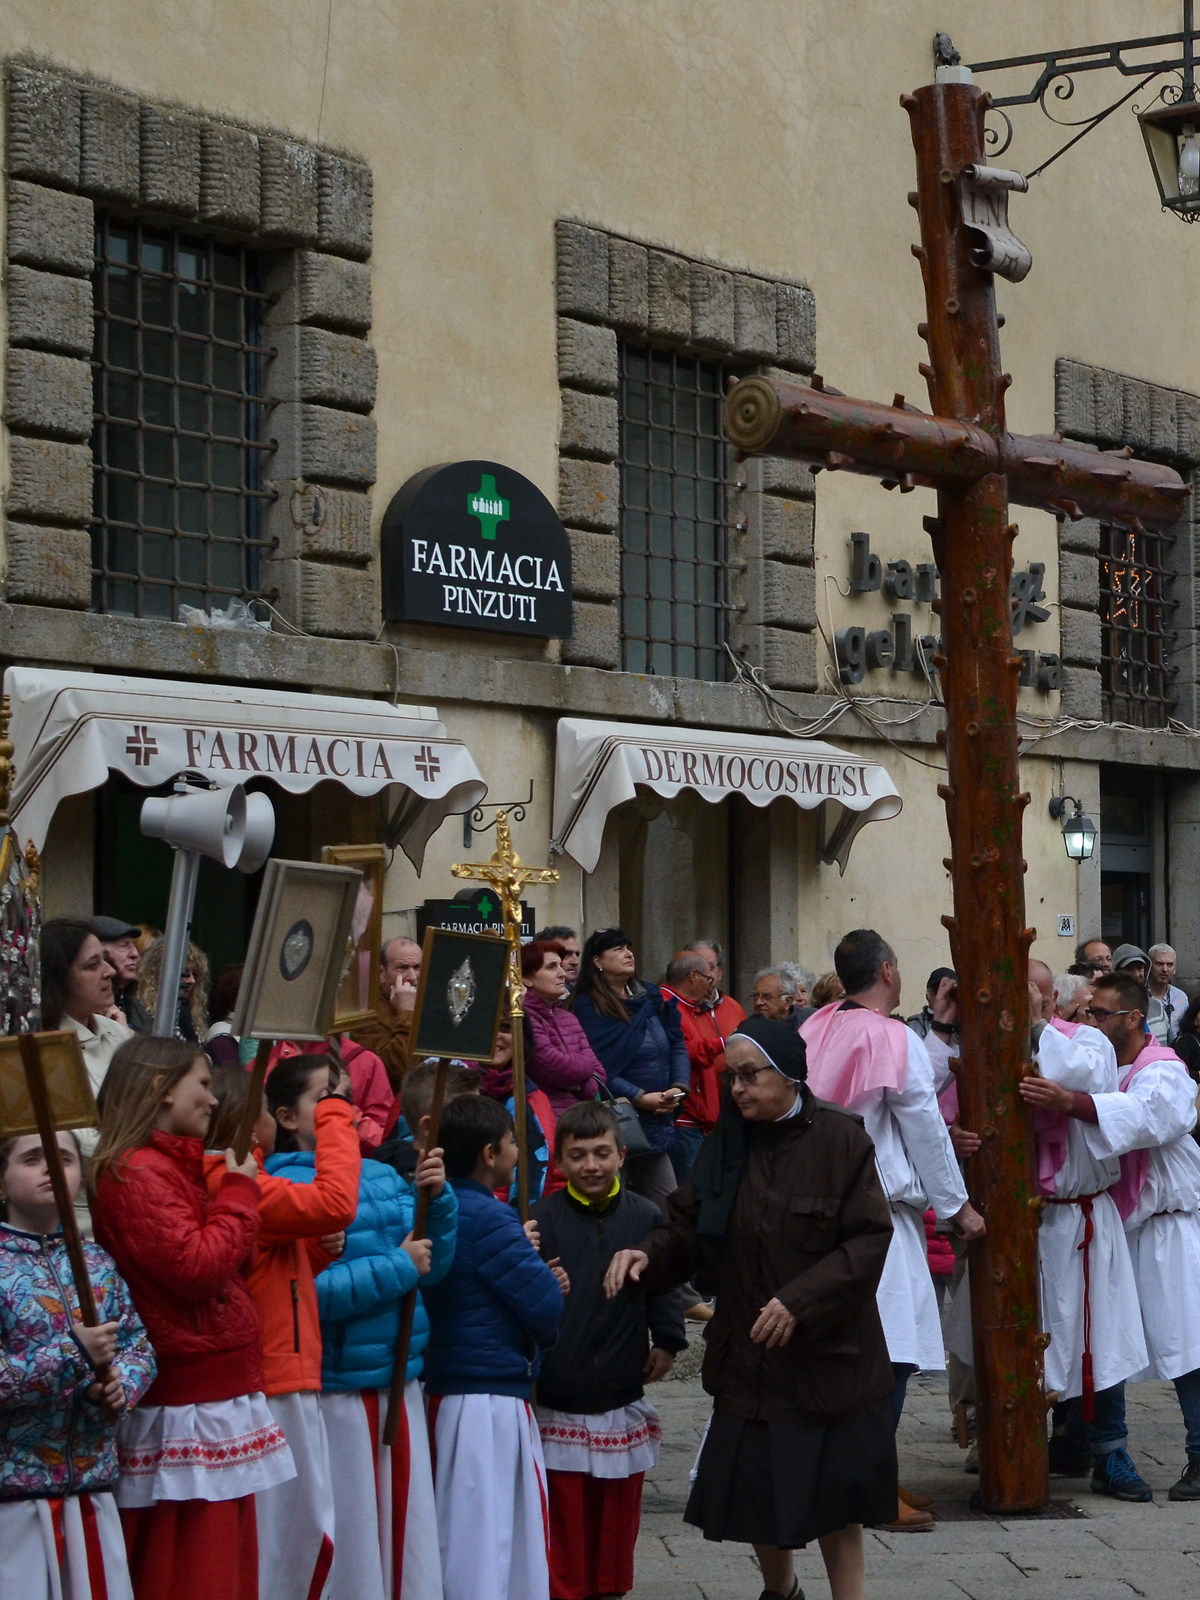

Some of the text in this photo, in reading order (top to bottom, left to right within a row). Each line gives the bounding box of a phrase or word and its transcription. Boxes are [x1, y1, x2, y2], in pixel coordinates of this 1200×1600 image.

[411, 539, 565, 592] FARMACIA
[442, 584, 537, 623] PINZUTI
[185, 728, 395, 780] FARMACIA
[640, 748, 872, 798] DERMOCOSMESI
